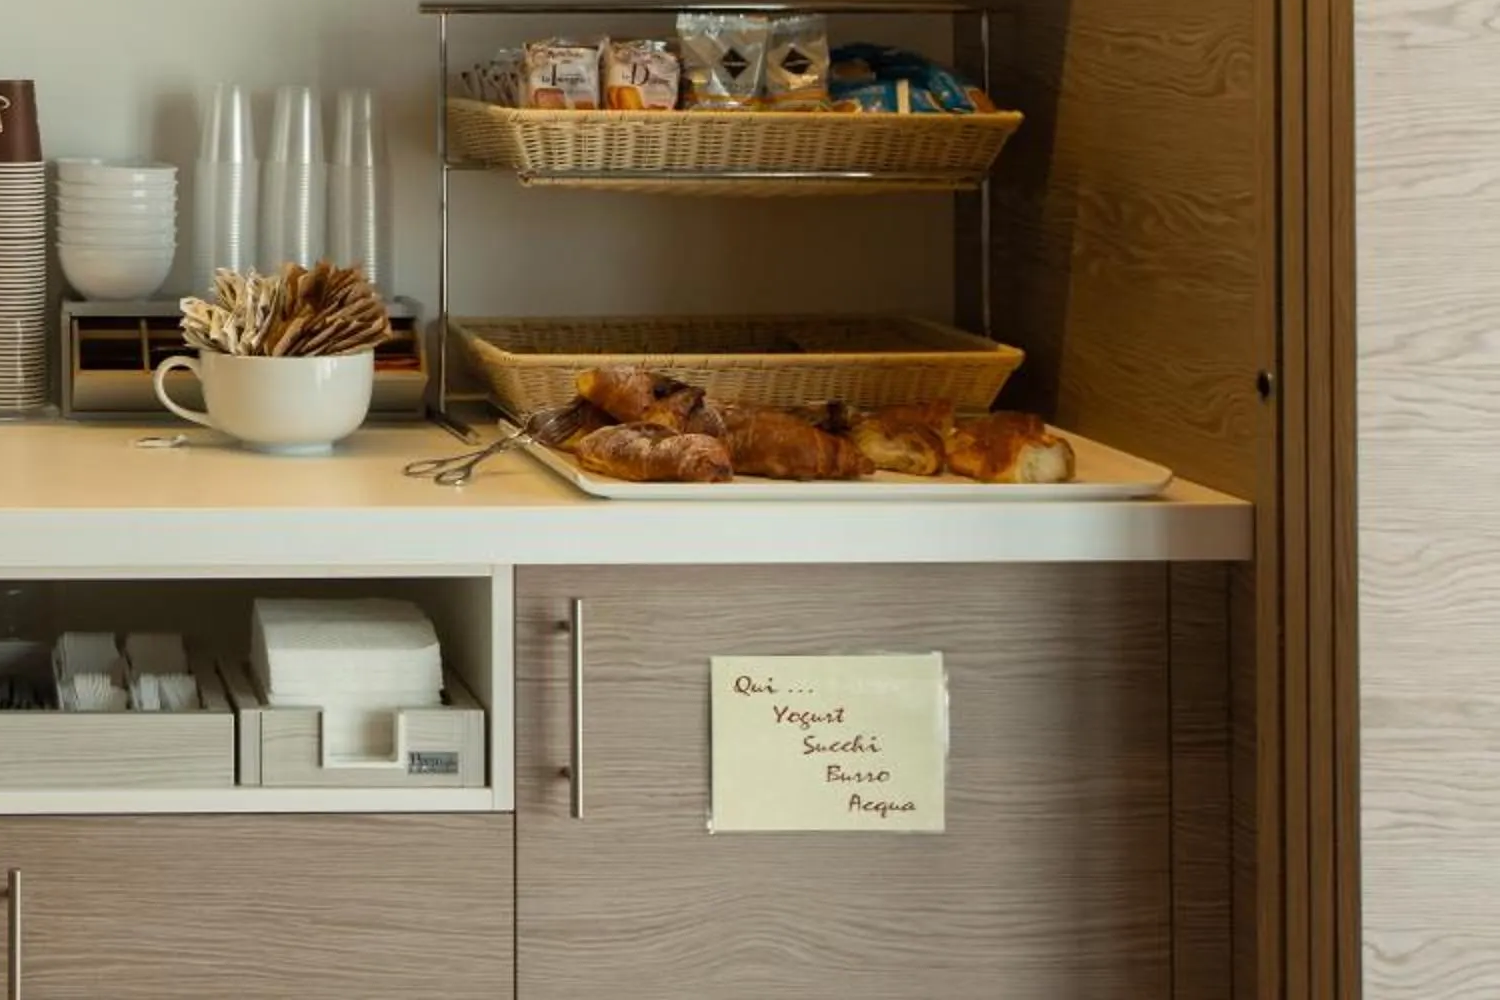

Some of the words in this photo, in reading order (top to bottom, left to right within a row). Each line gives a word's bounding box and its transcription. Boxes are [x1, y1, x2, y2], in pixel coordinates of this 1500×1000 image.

[772, 705, 845, 730] Yogurt
[802, 735, 884, 755] Succhi
[825, 764, 891, 783] Burro
[848, 793, 917, 818] Acqua
